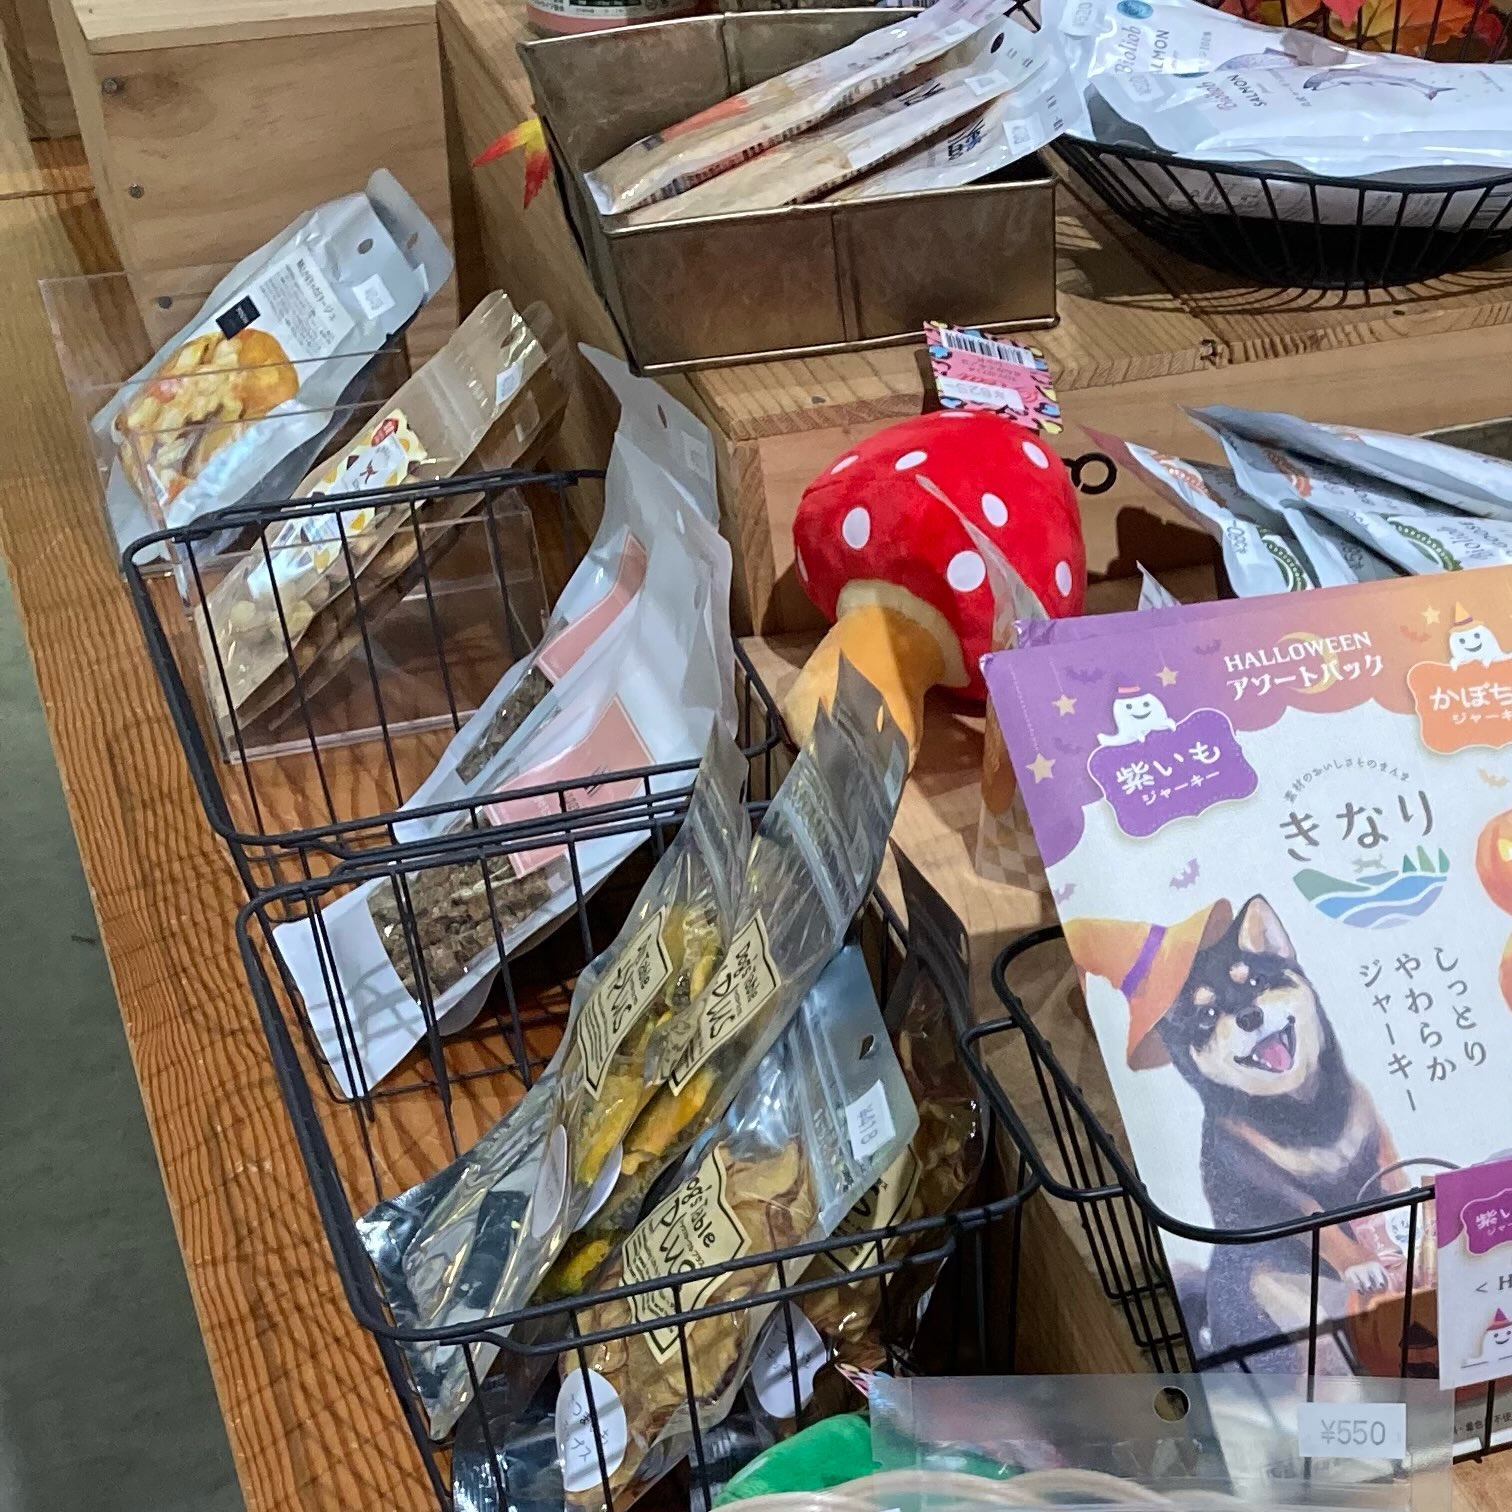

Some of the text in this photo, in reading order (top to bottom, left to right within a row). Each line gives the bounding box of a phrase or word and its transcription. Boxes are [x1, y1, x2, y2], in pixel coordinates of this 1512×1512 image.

[1152, 30, 1169, 74] LMON
[1224, 631, 1372, 673] HALLOWEEN
[1226, 654, 1384, 701] アソートパック
[1116, 741, 1221, 795] 紫いも
[1142, 770, 1221, 806] ジャーキー
[1279, 789, 1436, 863] きなり
[1394, 953, 1458, 1083] やわらか
[1433, 945, 1488, 1067] しっとり
[1357, 963, 1418, 1114] ジャーキー
[1320, 1418, 1387, 1447] ¥550
